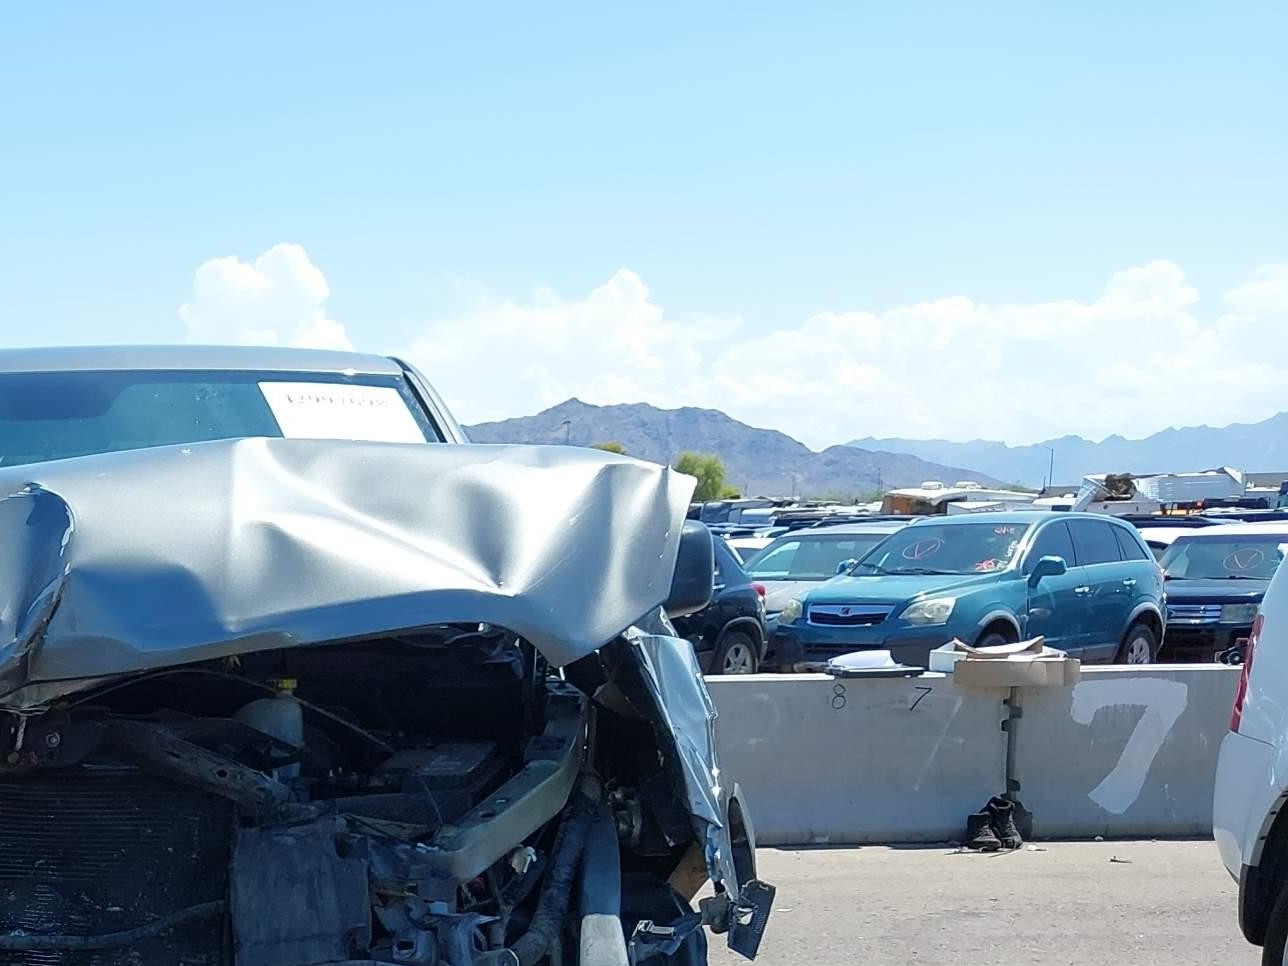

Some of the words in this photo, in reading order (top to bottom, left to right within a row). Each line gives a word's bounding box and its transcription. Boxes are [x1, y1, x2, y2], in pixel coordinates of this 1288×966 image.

[832, 683, 846, 709] 8
[910, 686, 932, 711] 7
[1070, 677, 1188, 814] 7
